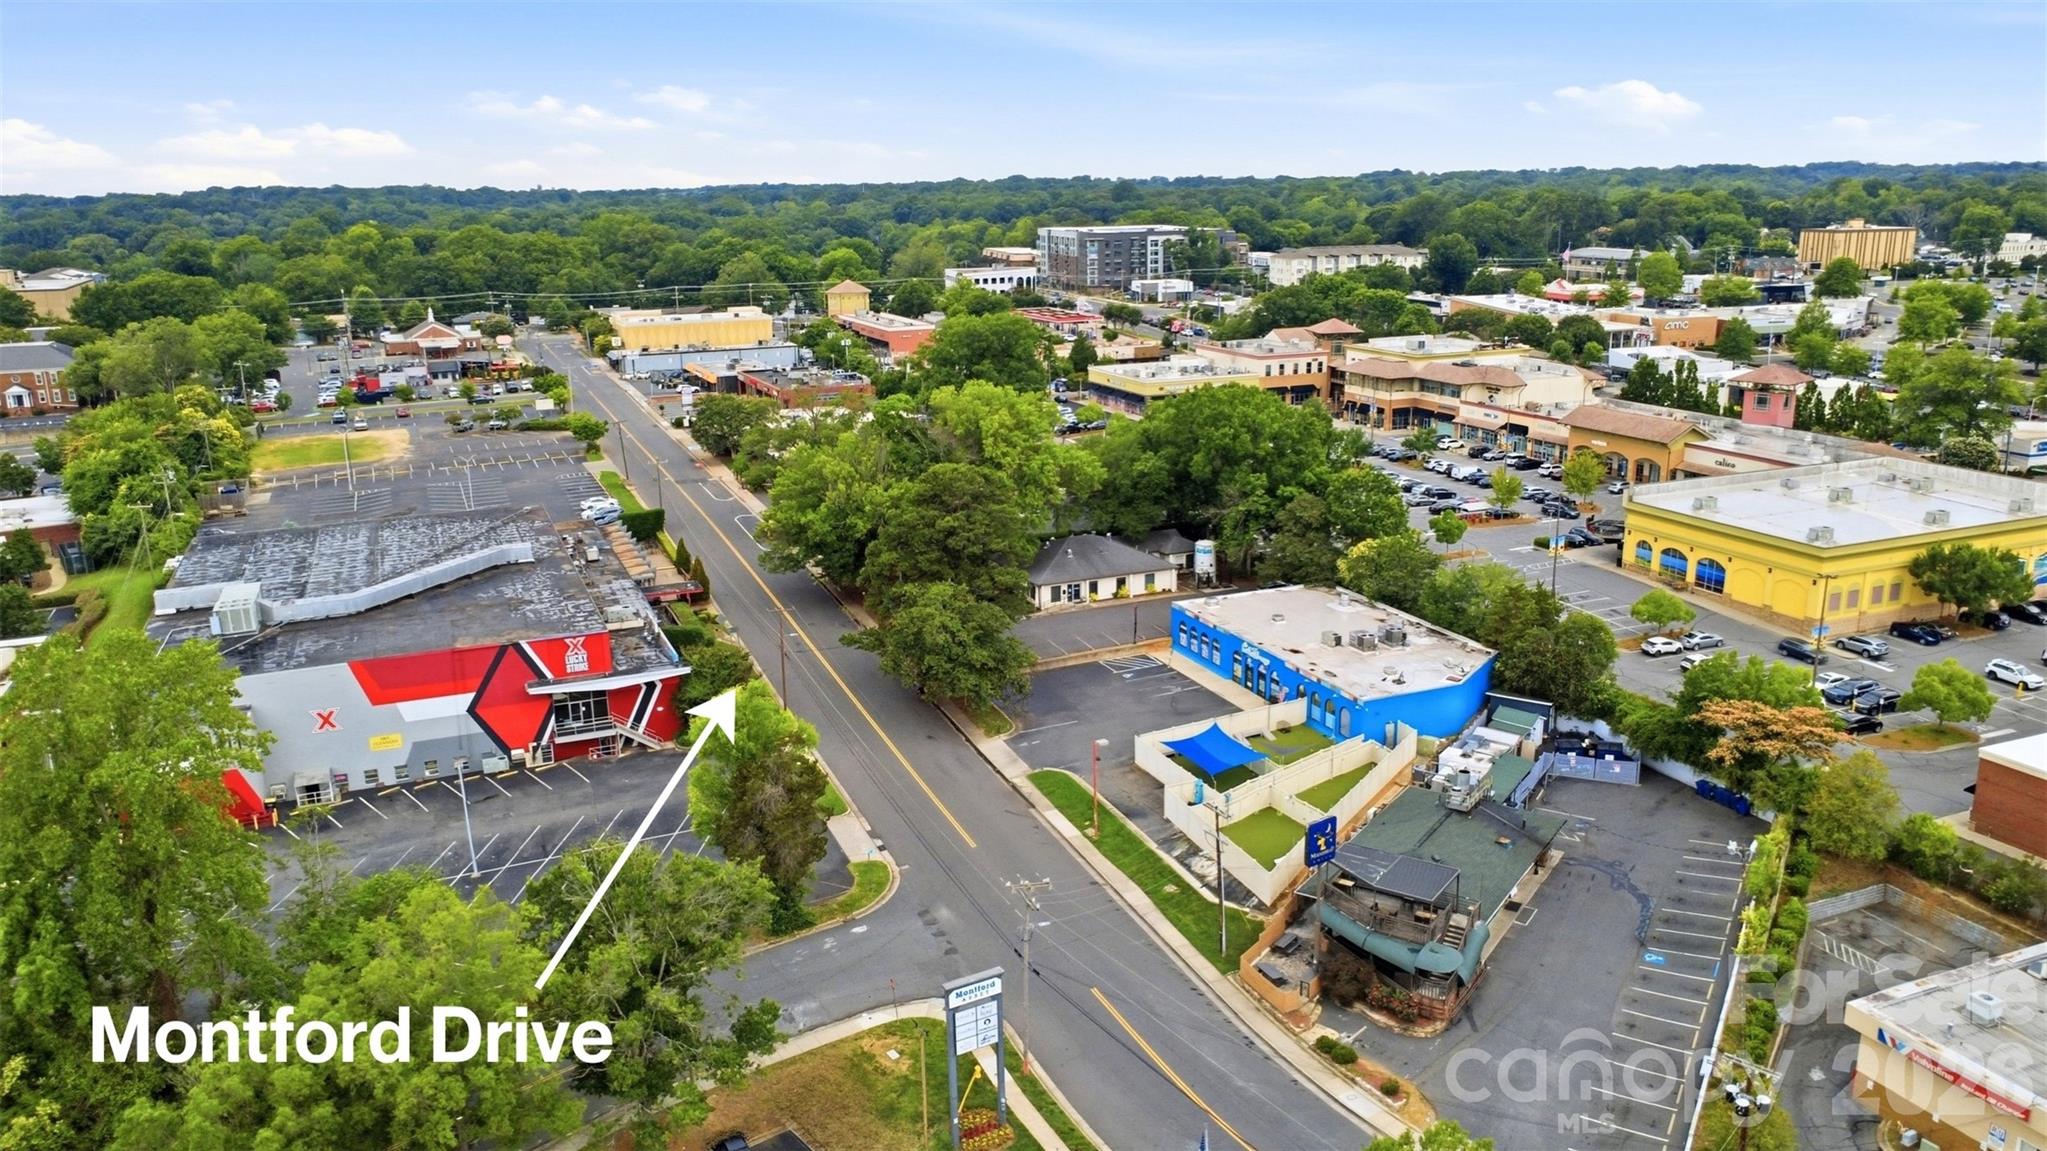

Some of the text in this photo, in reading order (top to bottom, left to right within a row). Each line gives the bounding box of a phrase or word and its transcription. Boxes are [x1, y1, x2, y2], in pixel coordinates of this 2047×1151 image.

[565, 654, 587, 664] LUCKY
[955, 980, 996, 999] Montford
[1911, 1051, 1955, 1083] Valvoline
